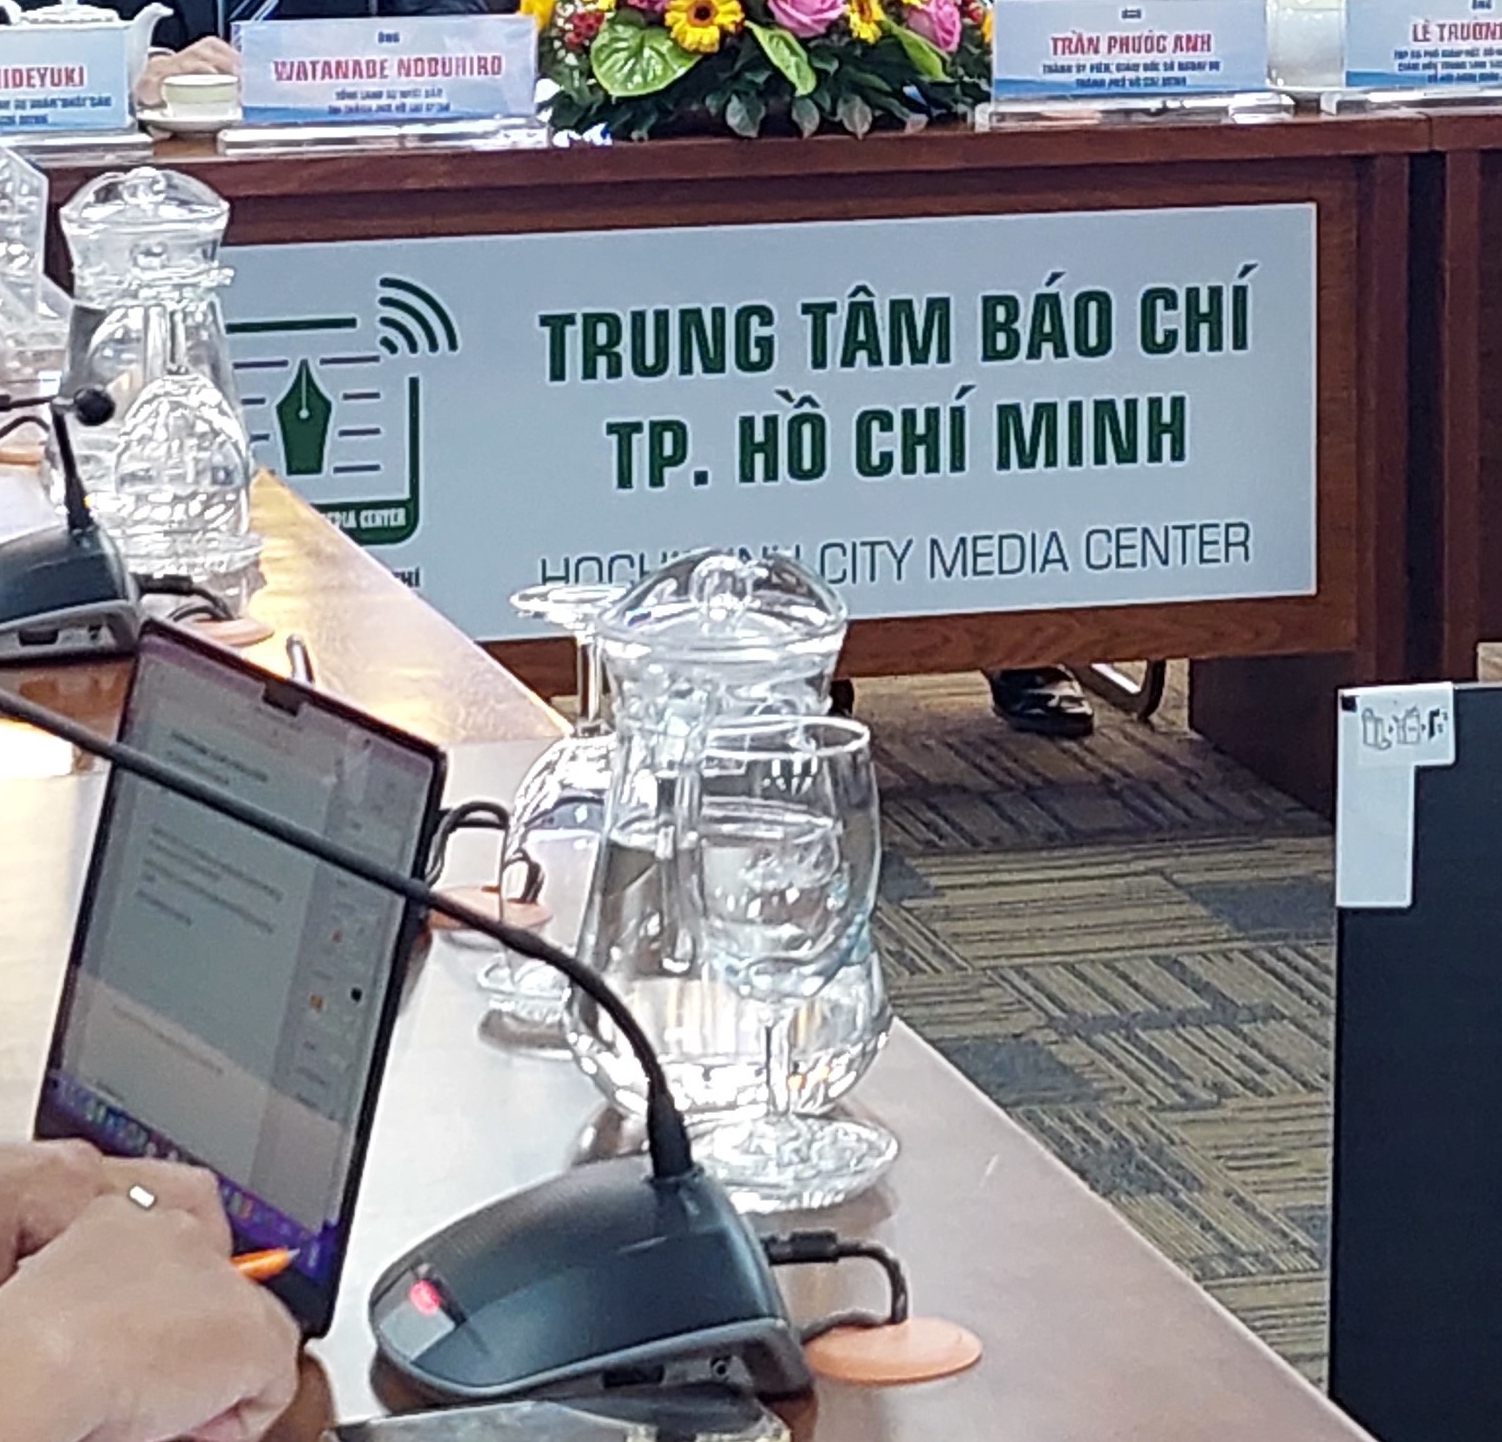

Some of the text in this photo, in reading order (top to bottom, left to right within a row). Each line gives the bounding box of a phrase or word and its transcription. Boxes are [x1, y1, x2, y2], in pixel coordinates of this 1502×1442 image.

[537, 263, 1259, 383] TRUNG TÂM BÁO CHÍ
[605, 384, 1187, 490] TP. HỒ CHÍ MINH
[818, 537, 914, 585] CITY
[928, 530, 1070, 580] MEDIA
[1085, 521, 1252, 571] CENTER
